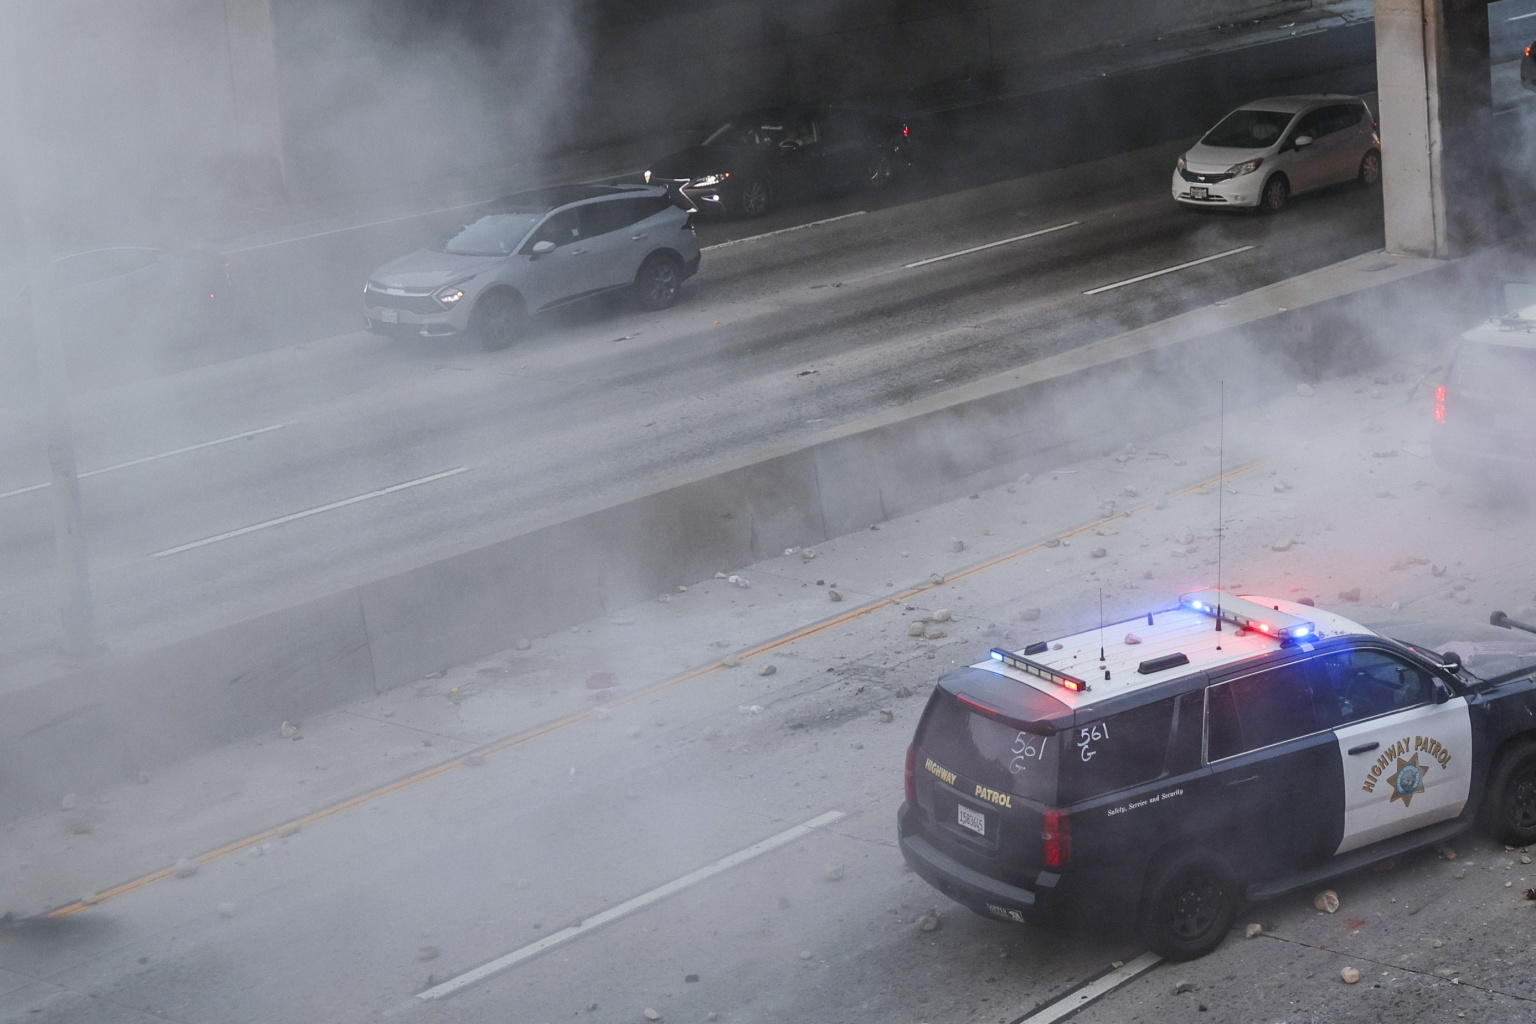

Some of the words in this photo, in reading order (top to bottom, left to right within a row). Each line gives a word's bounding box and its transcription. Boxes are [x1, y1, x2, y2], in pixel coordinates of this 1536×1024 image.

[1010, 731, 1048, 760] 561
[1077, 722, 1109, 746] 561
[1009, 756, 1026, 775] G
[1081, 745, 1097, 762] G
[1360, 736, 1410, 793] HIGHWAY
[1414, 735, 1452, 769] PATROL
[925, 758, 957, 785] HIGHWAY
[975, 784, 1012, 808] PATROL
[1107, 806, 1127, 817] Safety,
[1128, 802, 1148, 810] Service
[1149, 795, 1160, 803] and
[1161, 788, 1184, 800] Security
